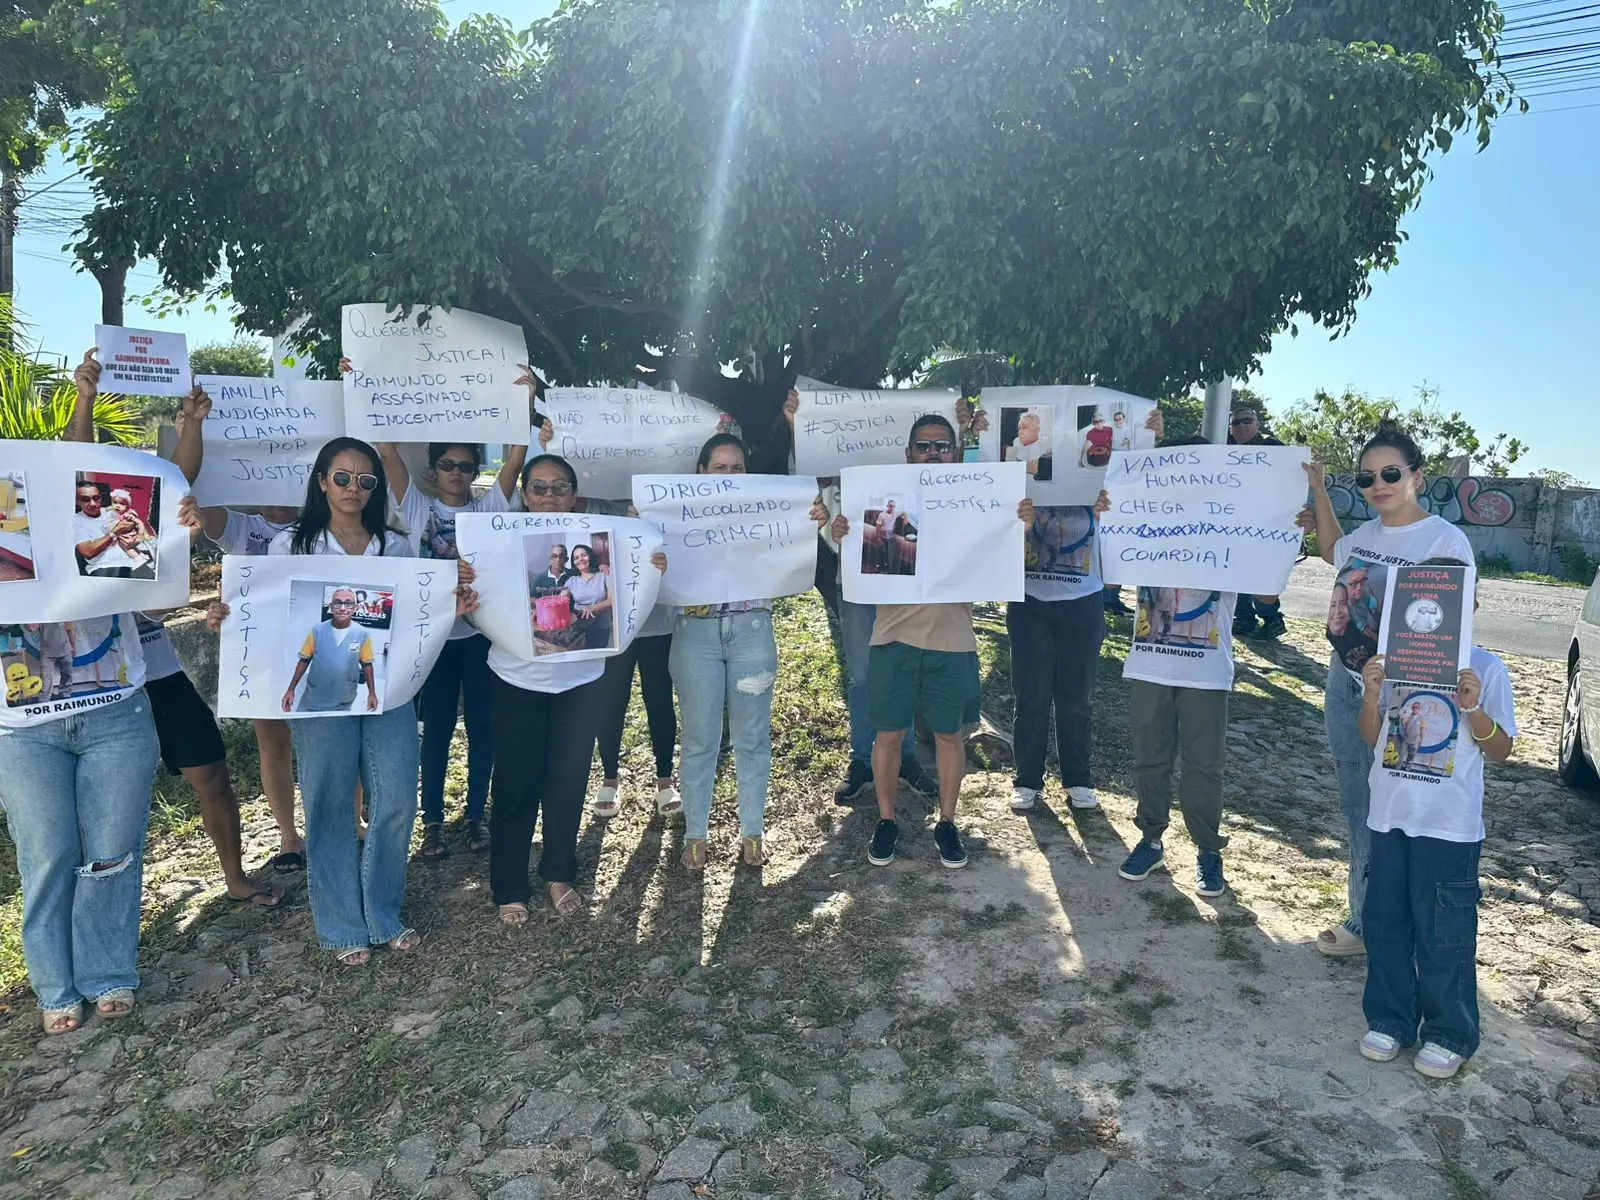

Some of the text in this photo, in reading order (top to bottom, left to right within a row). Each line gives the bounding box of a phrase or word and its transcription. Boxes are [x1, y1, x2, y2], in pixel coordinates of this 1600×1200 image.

[348, 308, 447, 339] QUEREMOS
[128, 335, 153, 345] JUSTIÇA
[135, 346, 148, 354] POR
[105, 363, 118, 371] QUE
[115, 354, 170, 365] RAIMUNDO PLUMA
[114, 372, 124, 380] UM
[350, 368, 494, 389] RAIMUNDO FOI
[371, 390, 472, 406] ASSASINADO
[558, 409, 703, 426] NÃO FOI ACIDENTE
[224, 424, 300, 441] CLAMA
[258, 439, 307, 454] POR
[562, 436, 658, 461] QUEREMOS
[828, 436, 906, 455] RAIMUNDO
[1124, 450, 1272, 474] VAMOS SER
[919, 468, 994, 487] QUEREMOS
[1145, 473, 1242, 489] HUMANOS
[644, 479, 741, 504] DIRIGIR
[681, 499, 793, 522] ALCOOLIZADO
[1119, 500, 1236, 515] CHEGA DE
[491, 514, 591, 531] QUEREMOS
[1042, 574, 1082, 584] RAIMUNDO
[1407, 571, 1450, 581] JUSTIÇA
[1411, 592, 1441, 600] PLUMA
[1135, 644, 1205, 659] POR RAIMUNDO
[25, 693, 122, 716] POR RAIMUNDO
